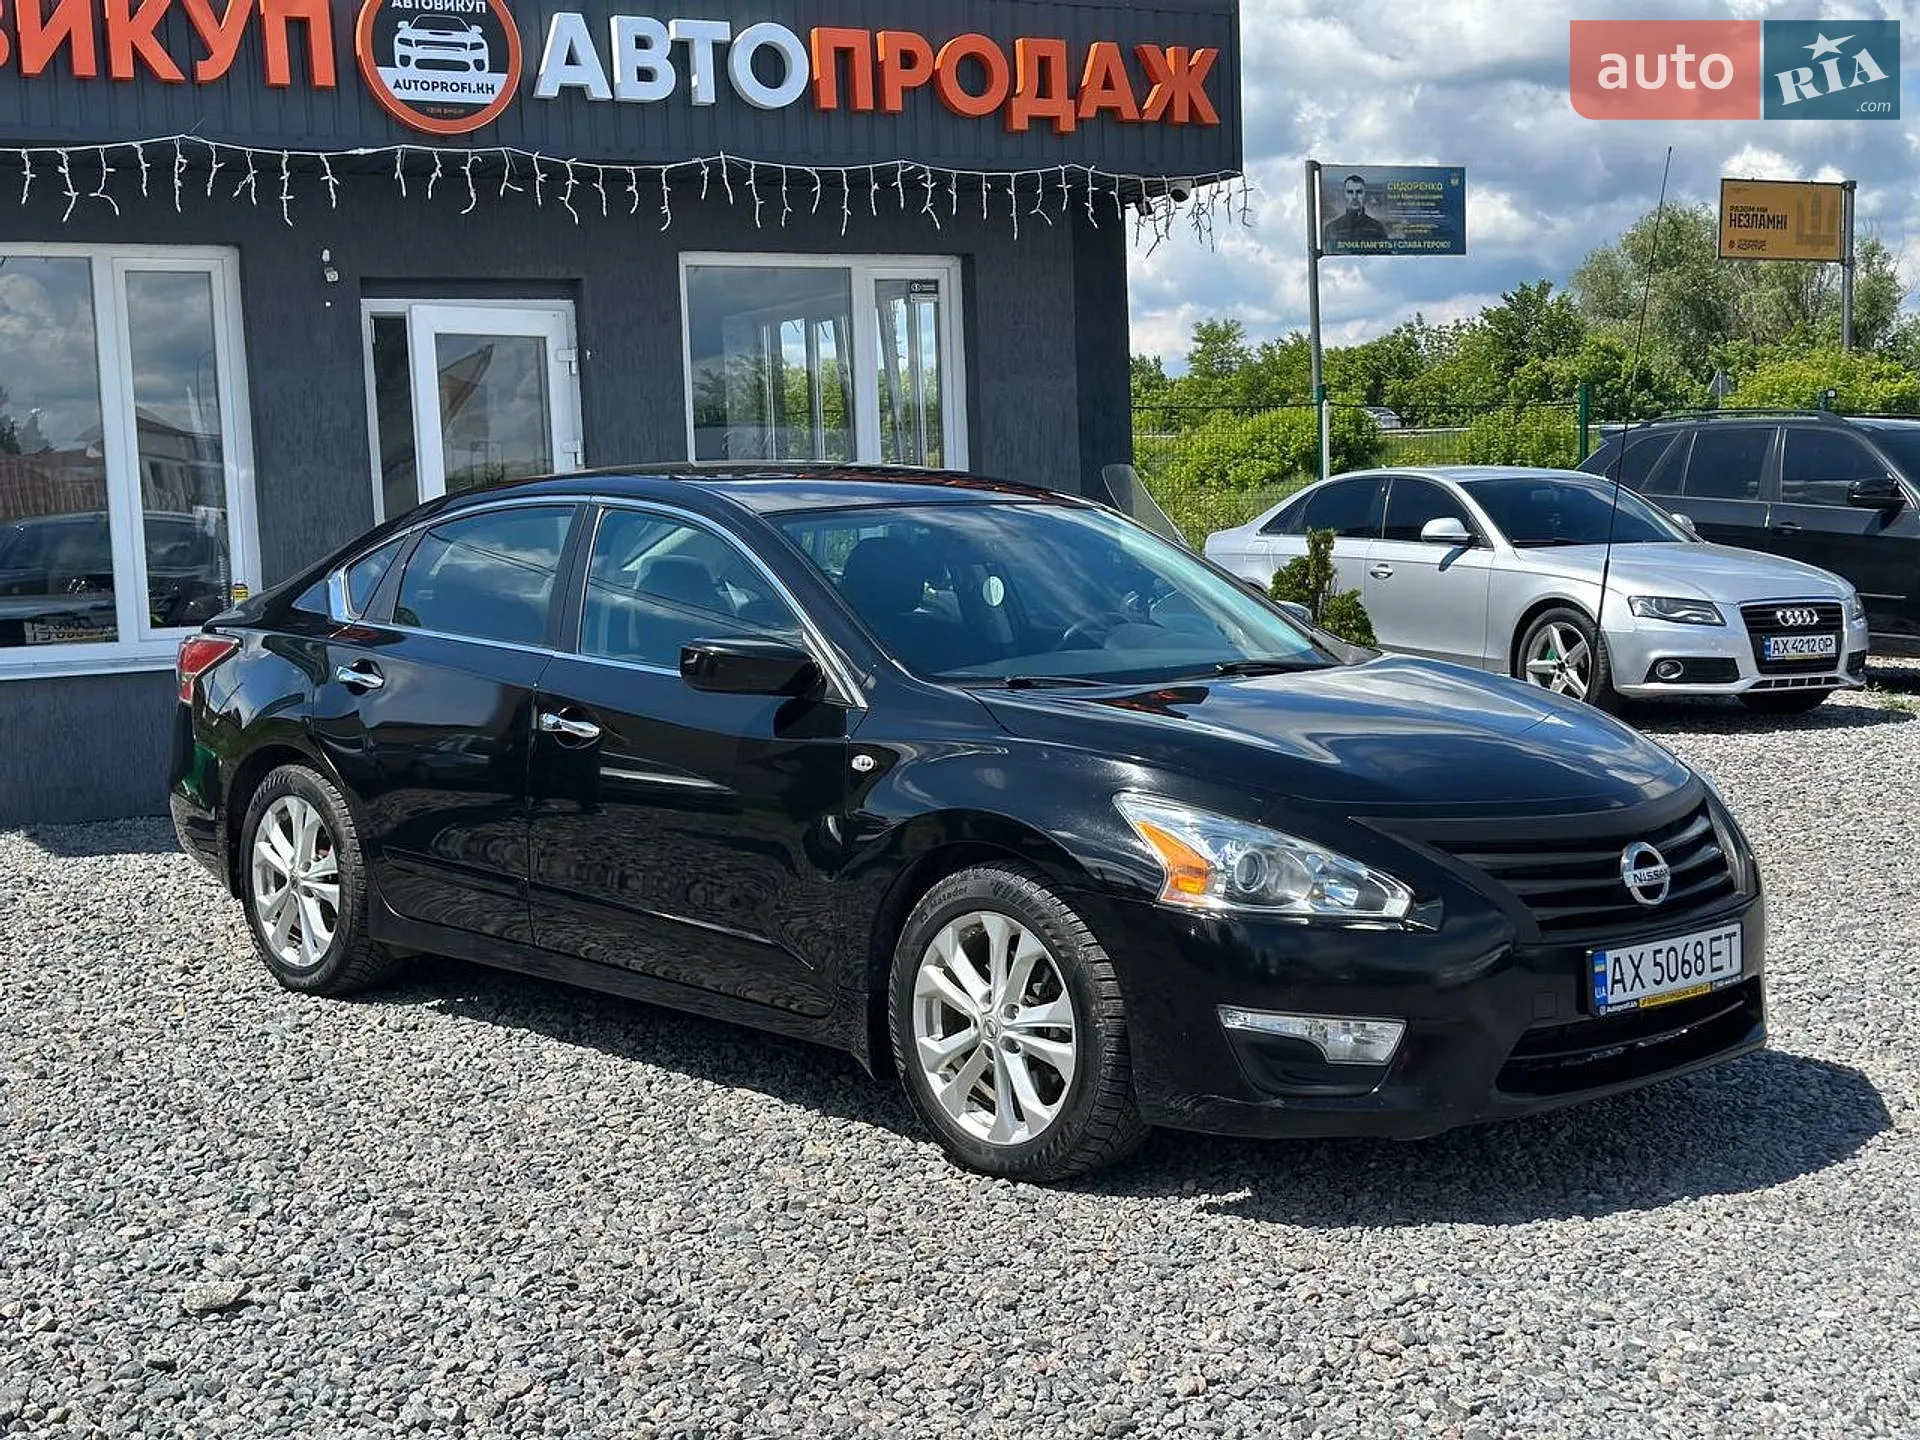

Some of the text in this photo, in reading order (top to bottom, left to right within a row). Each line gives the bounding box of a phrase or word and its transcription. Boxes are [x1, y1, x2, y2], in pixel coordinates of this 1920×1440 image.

[393, 79, 495, 95] AUTOPROFI.KH
[1729, 212, 1788, 230] НЕЗЛАМНІ
[1609, 951, 1647, 996] AX
